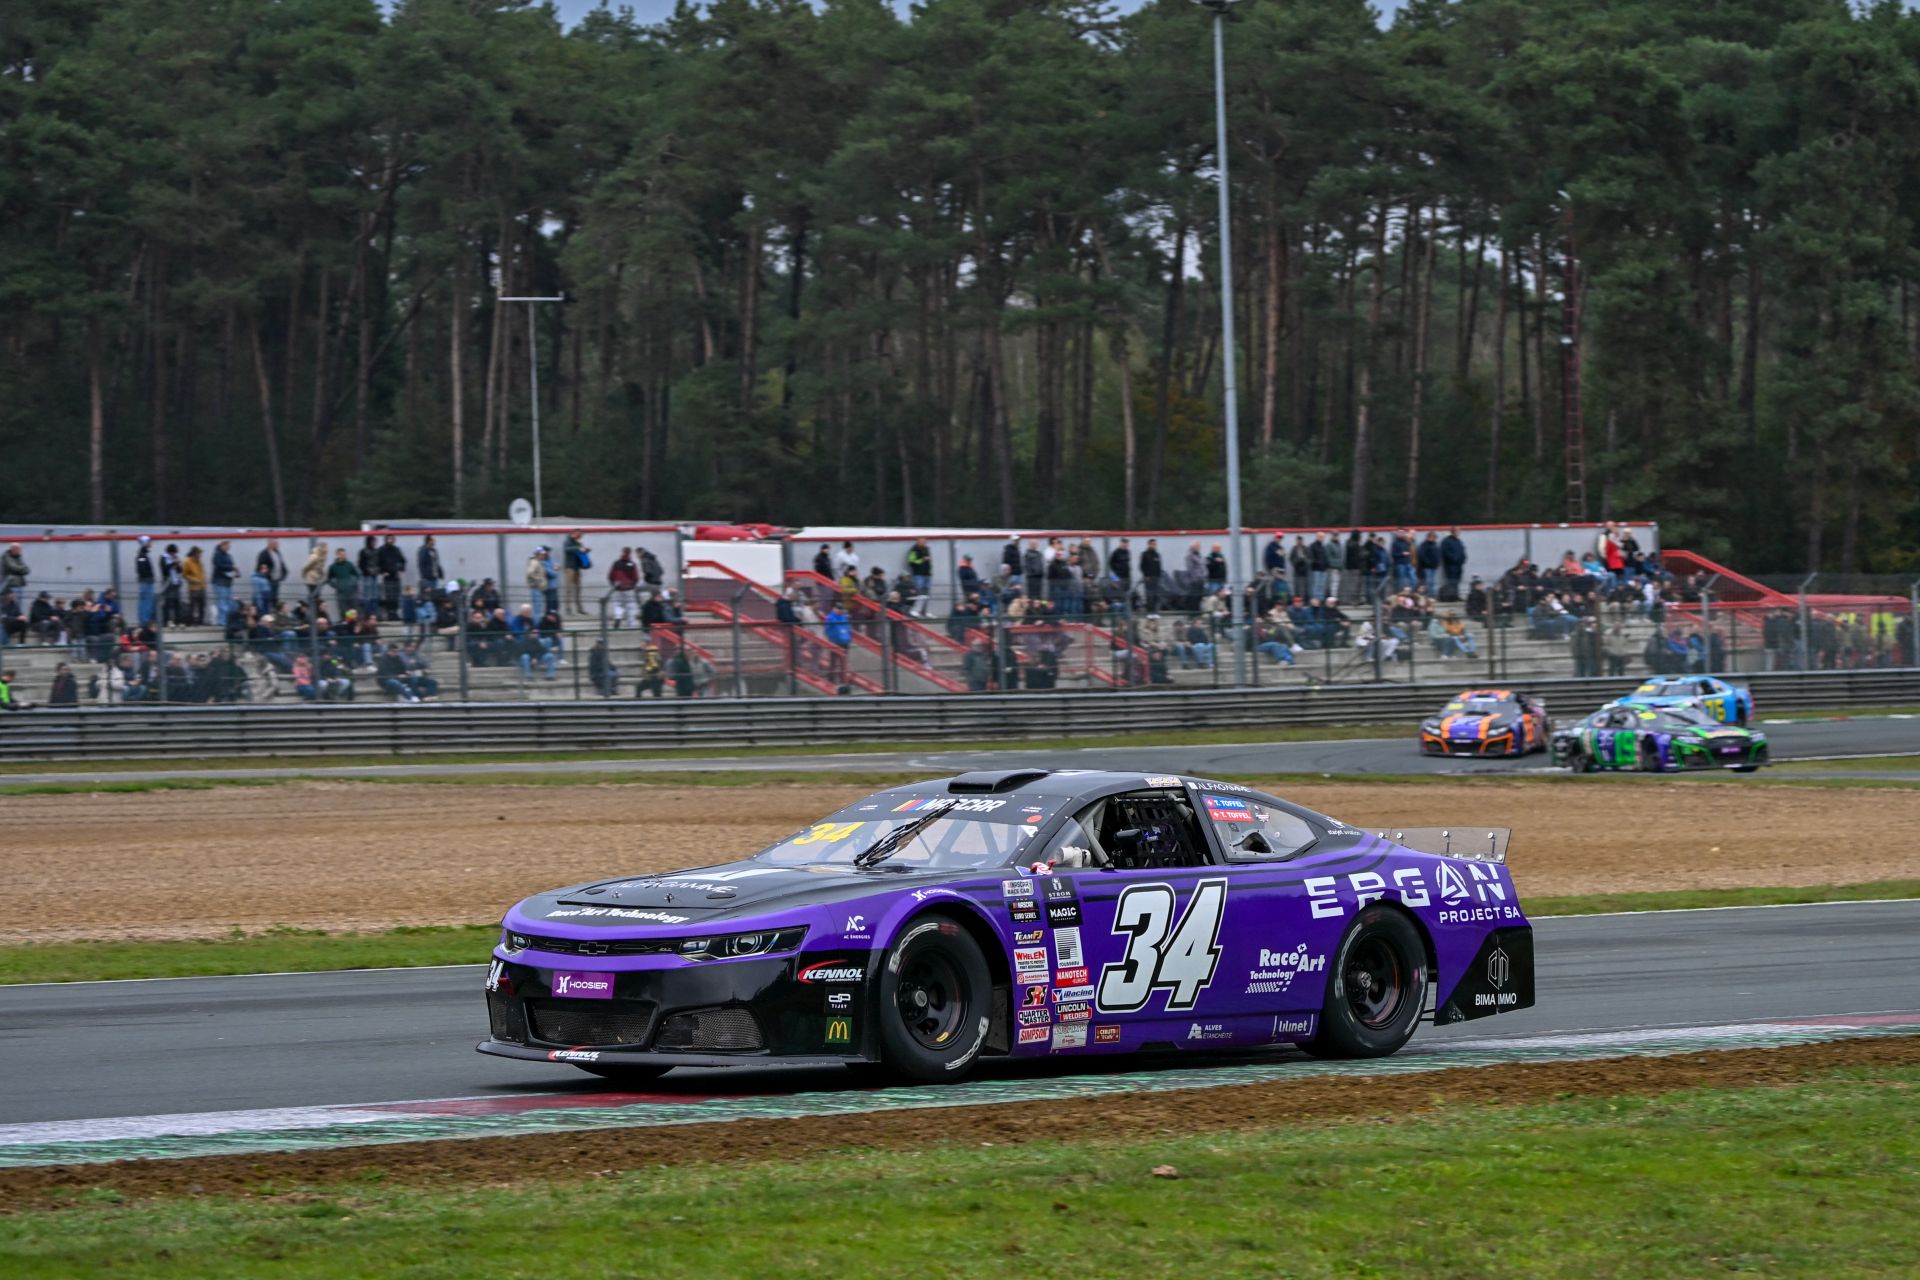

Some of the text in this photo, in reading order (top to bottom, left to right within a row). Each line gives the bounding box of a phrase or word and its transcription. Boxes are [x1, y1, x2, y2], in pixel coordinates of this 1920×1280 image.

[793, 821, 865, 846] 34
[606, 907, 690, 924] Technology
[1049, 907, 1077, 918] MAGIC
[1439, 907, 1520, 924] PROJECT SA
[1095, 877, 1228, 1014] 34
[1259, 948, 1326, 972] Race Art
[802, 968, 863, 980] KENNOL
[1057, 970, 1088, 980] NANOTECH
[1250, 969, 1295, 981] Technology
[569, 981, 609, 990] HOOSIER
[1063, 989, 1094, 998] iRacing
[1475, 992, 1517, 1006] BIMA IMMO
[1057, 1003, 1086, 1013] LINCOLN
[1063, 1011, 1089, 1020] WELDERS
[1020, 1028, 1048, 1041] SIMPSON
